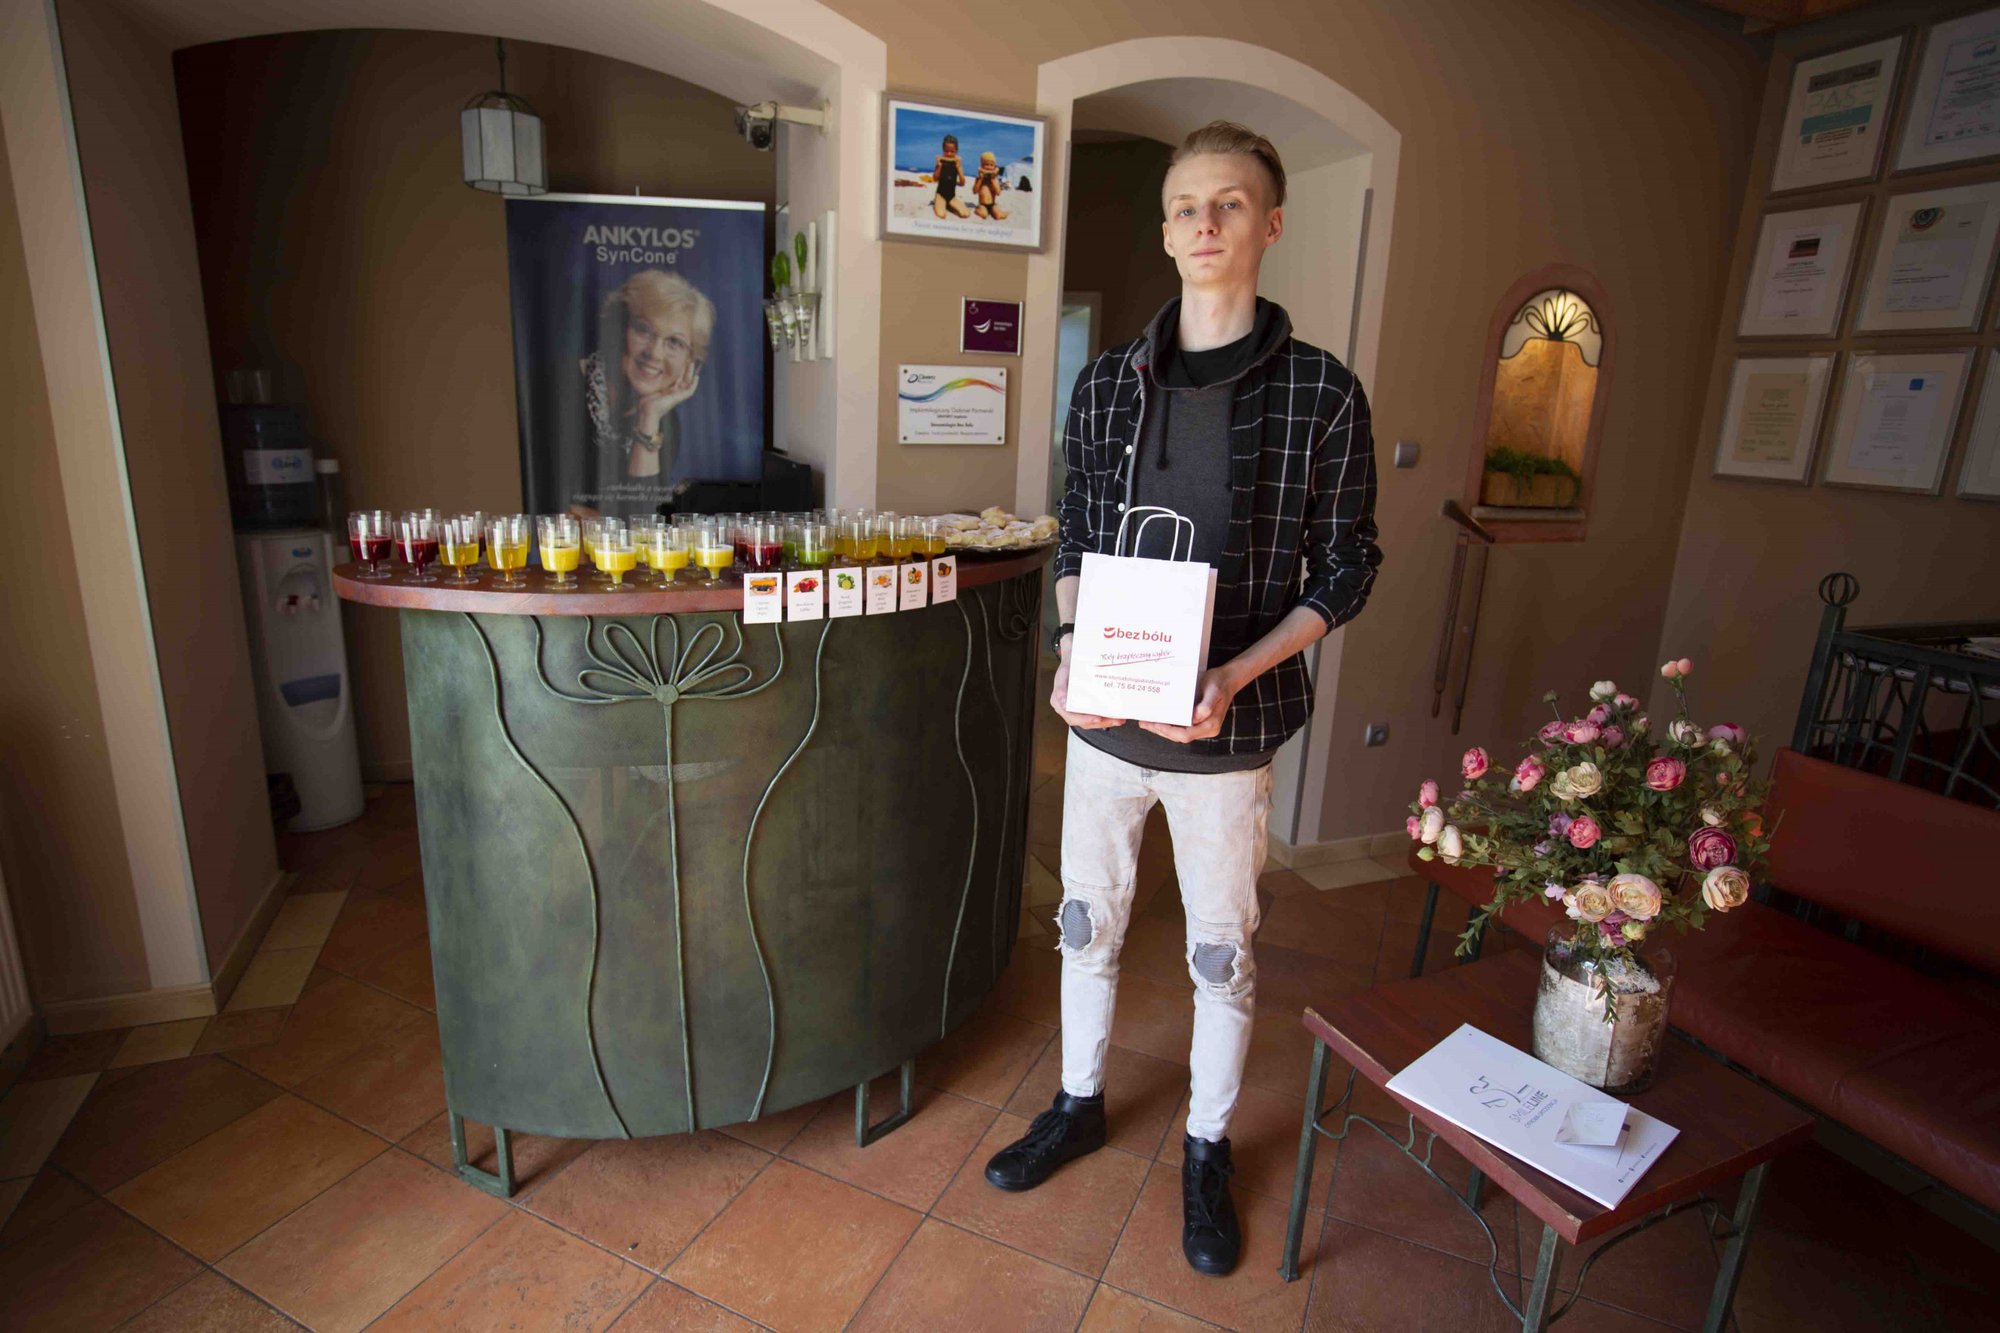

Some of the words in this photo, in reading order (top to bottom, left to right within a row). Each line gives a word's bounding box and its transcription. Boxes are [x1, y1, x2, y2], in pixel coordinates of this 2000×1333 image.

[596, 246, 677, 266] SynCone
[1116, 627, 1140, 640] bez
[1142, 629, 1172, 643] bólu
[1117, 682, 1126, 690] 75
[1137, 684, 1146, 692] 24
[1147, 686, 1161, 694] 558
